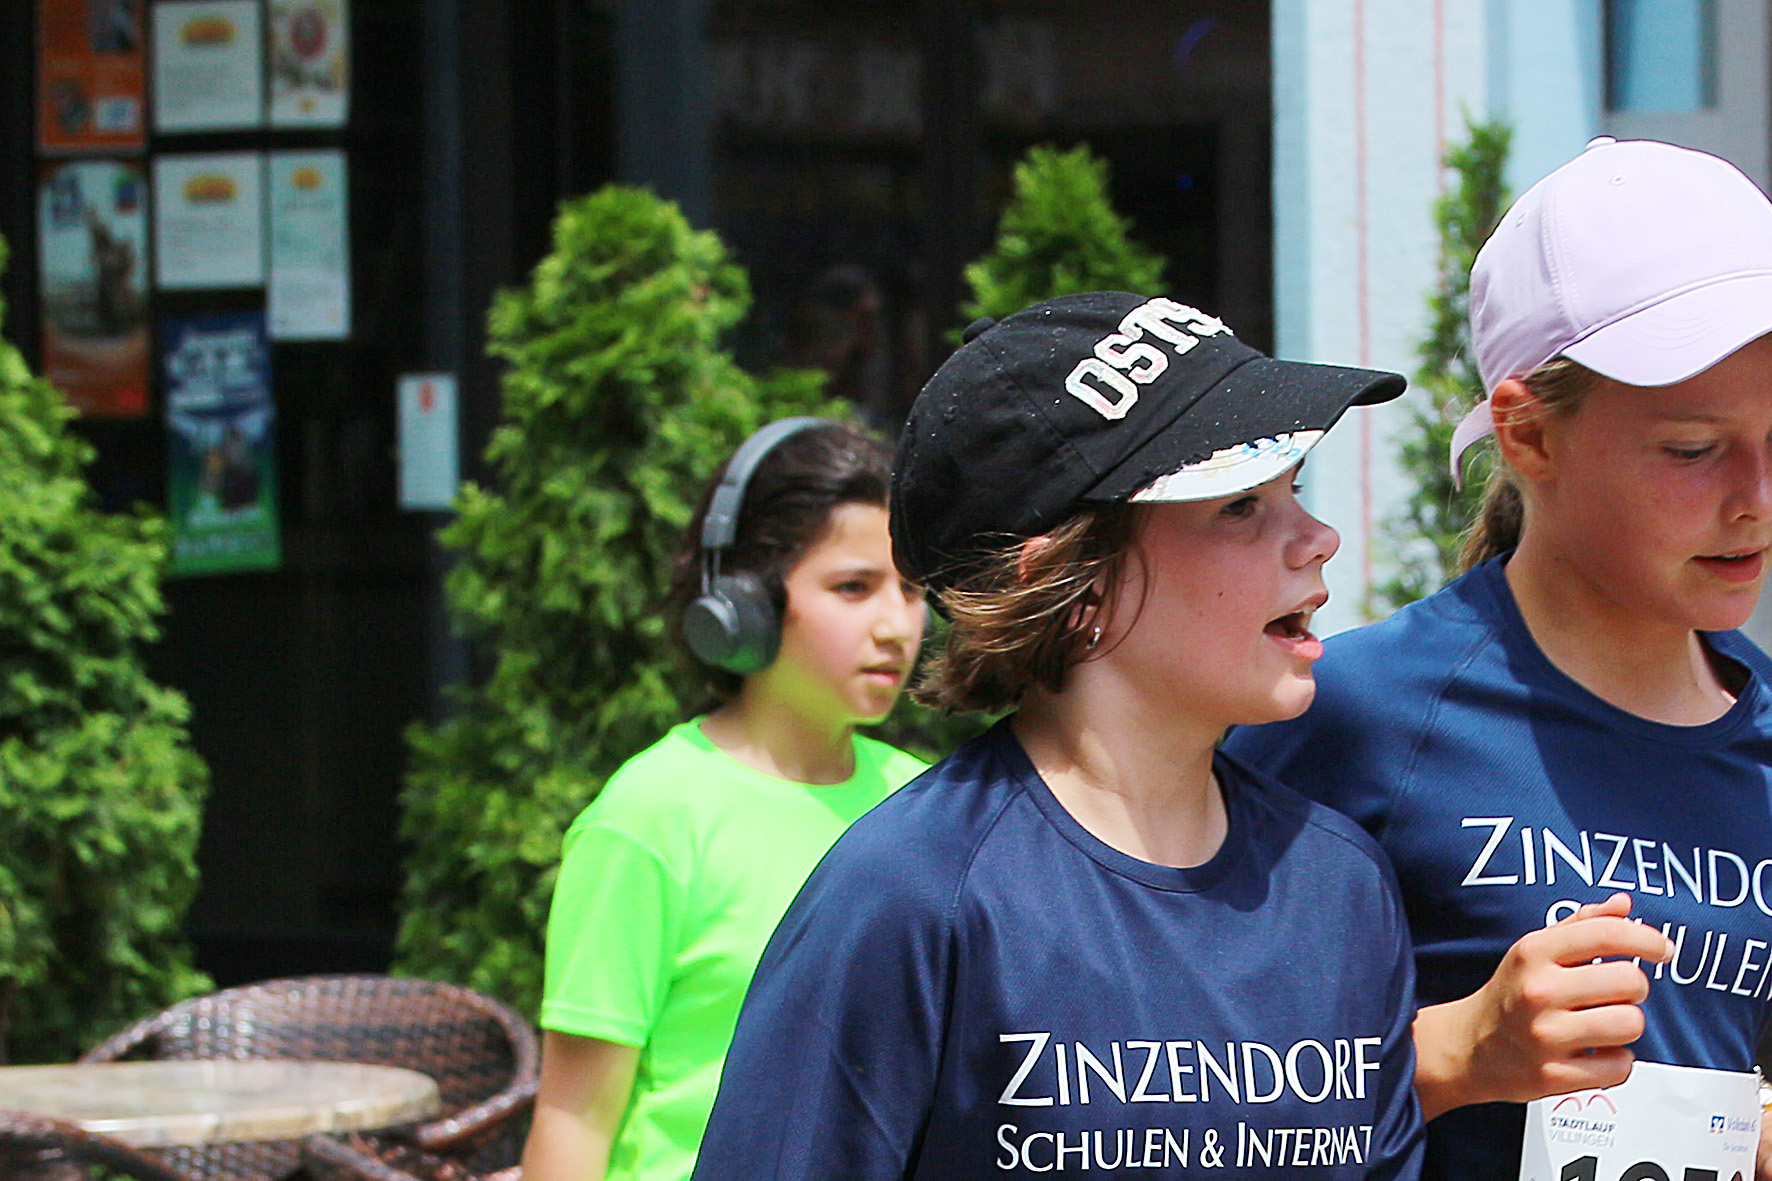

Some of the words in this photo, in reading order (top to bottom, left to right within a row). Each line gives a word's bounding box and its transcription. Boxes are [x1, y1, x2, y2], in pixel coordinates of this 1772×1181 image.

[998, 1032, 1382, 1106] ZINZENDORF
[997, 1124, 1190, 1172] SCHULEN
[1200, 1128, 1225, 1168] &
[1236, 1122, 1373, 1167] INTERNAT
[1551, 1117, 1616, 1133] STADTLAUF
